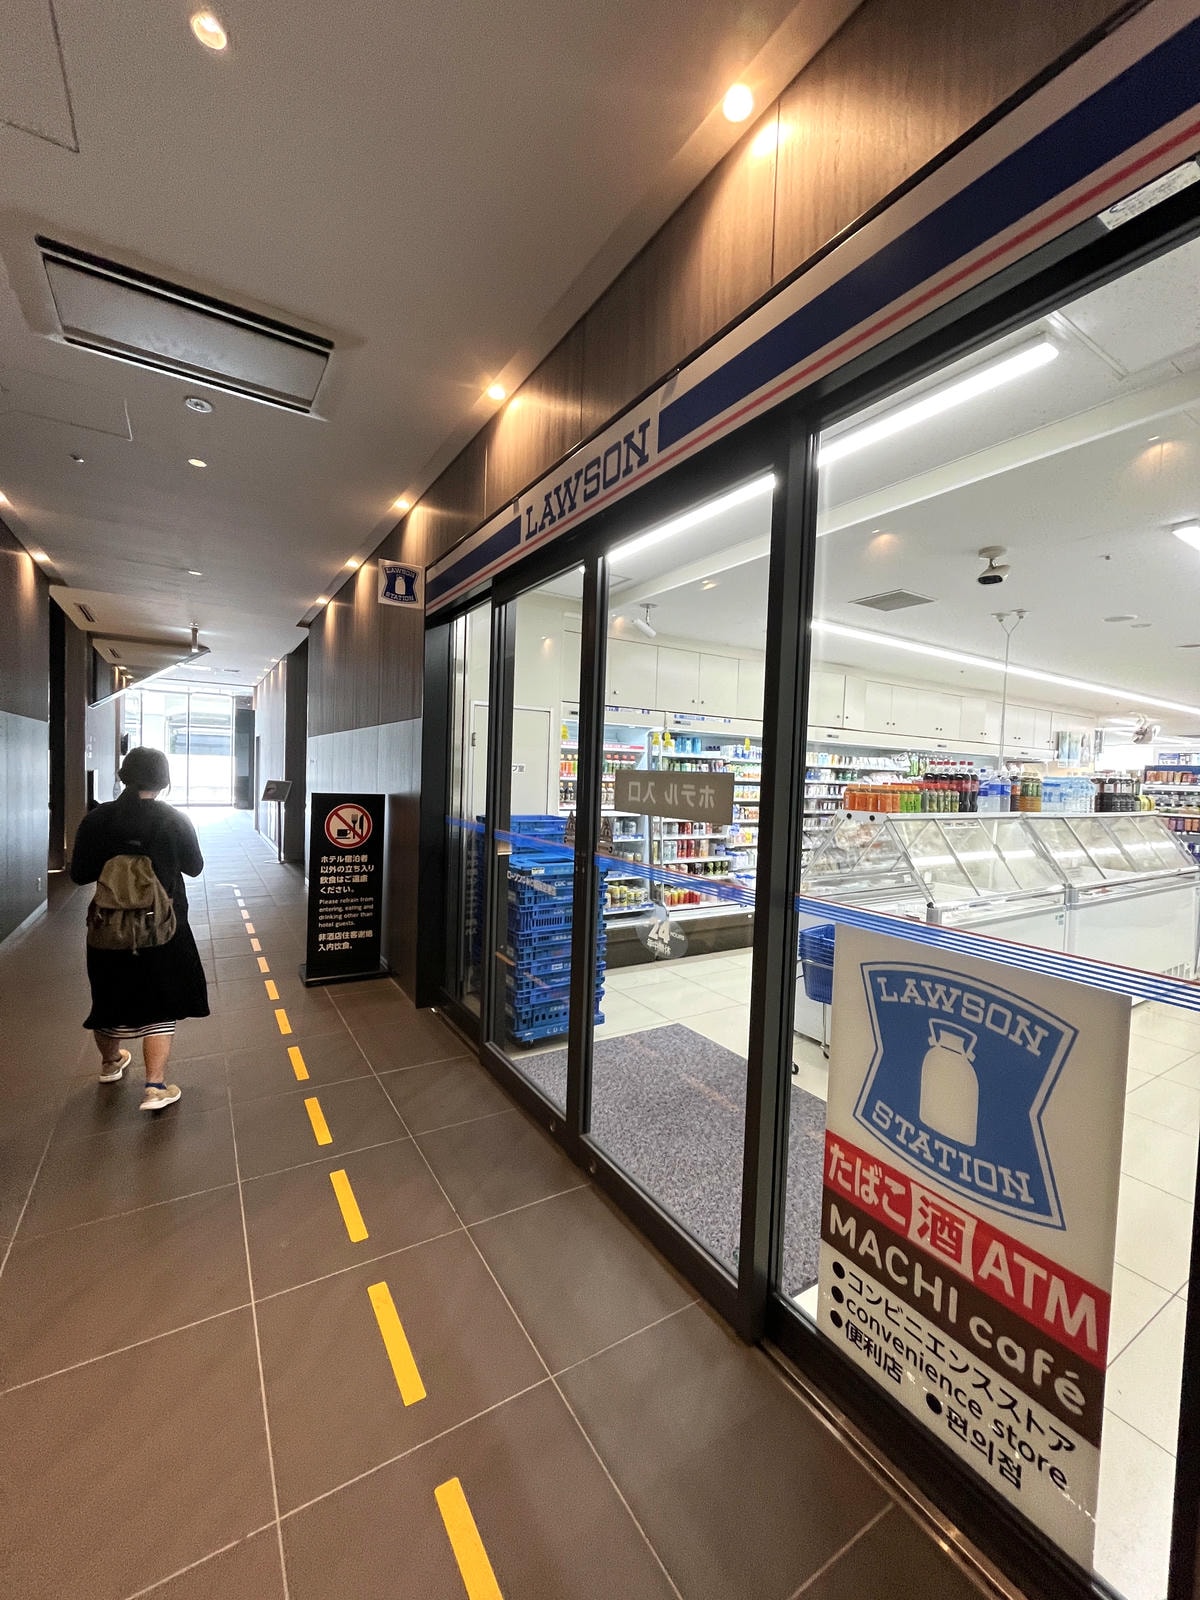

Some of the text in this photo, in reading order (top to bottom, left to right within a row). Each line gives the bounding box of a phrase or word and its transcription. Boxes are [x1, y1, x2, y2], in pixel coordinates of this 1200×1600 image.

[525, 418, 652, 541] LAWSON
[385, 567, 417, 579] LAWSON
[385, 591, 415, 601] STATION
[319, 886, 355, 894] ください。
[320, 864, 375, 874] 以外の立ち入り
[647, 917, 671, 945] 24
[877, 976, 1050, 1057] LAWSON
[871, 1100, 1035, 1205] STATION
[828, 1143, 1099, 1353] たばこ 酒 ATM
[829, 1203, 1087, 1417] MACHI café
[847, 1271, 1077, 1453] コンビニエンスストア
[844, 1318, 1022, 1491] 便利店 편의점
[845, 1298, 1068, 1492] convenience store
